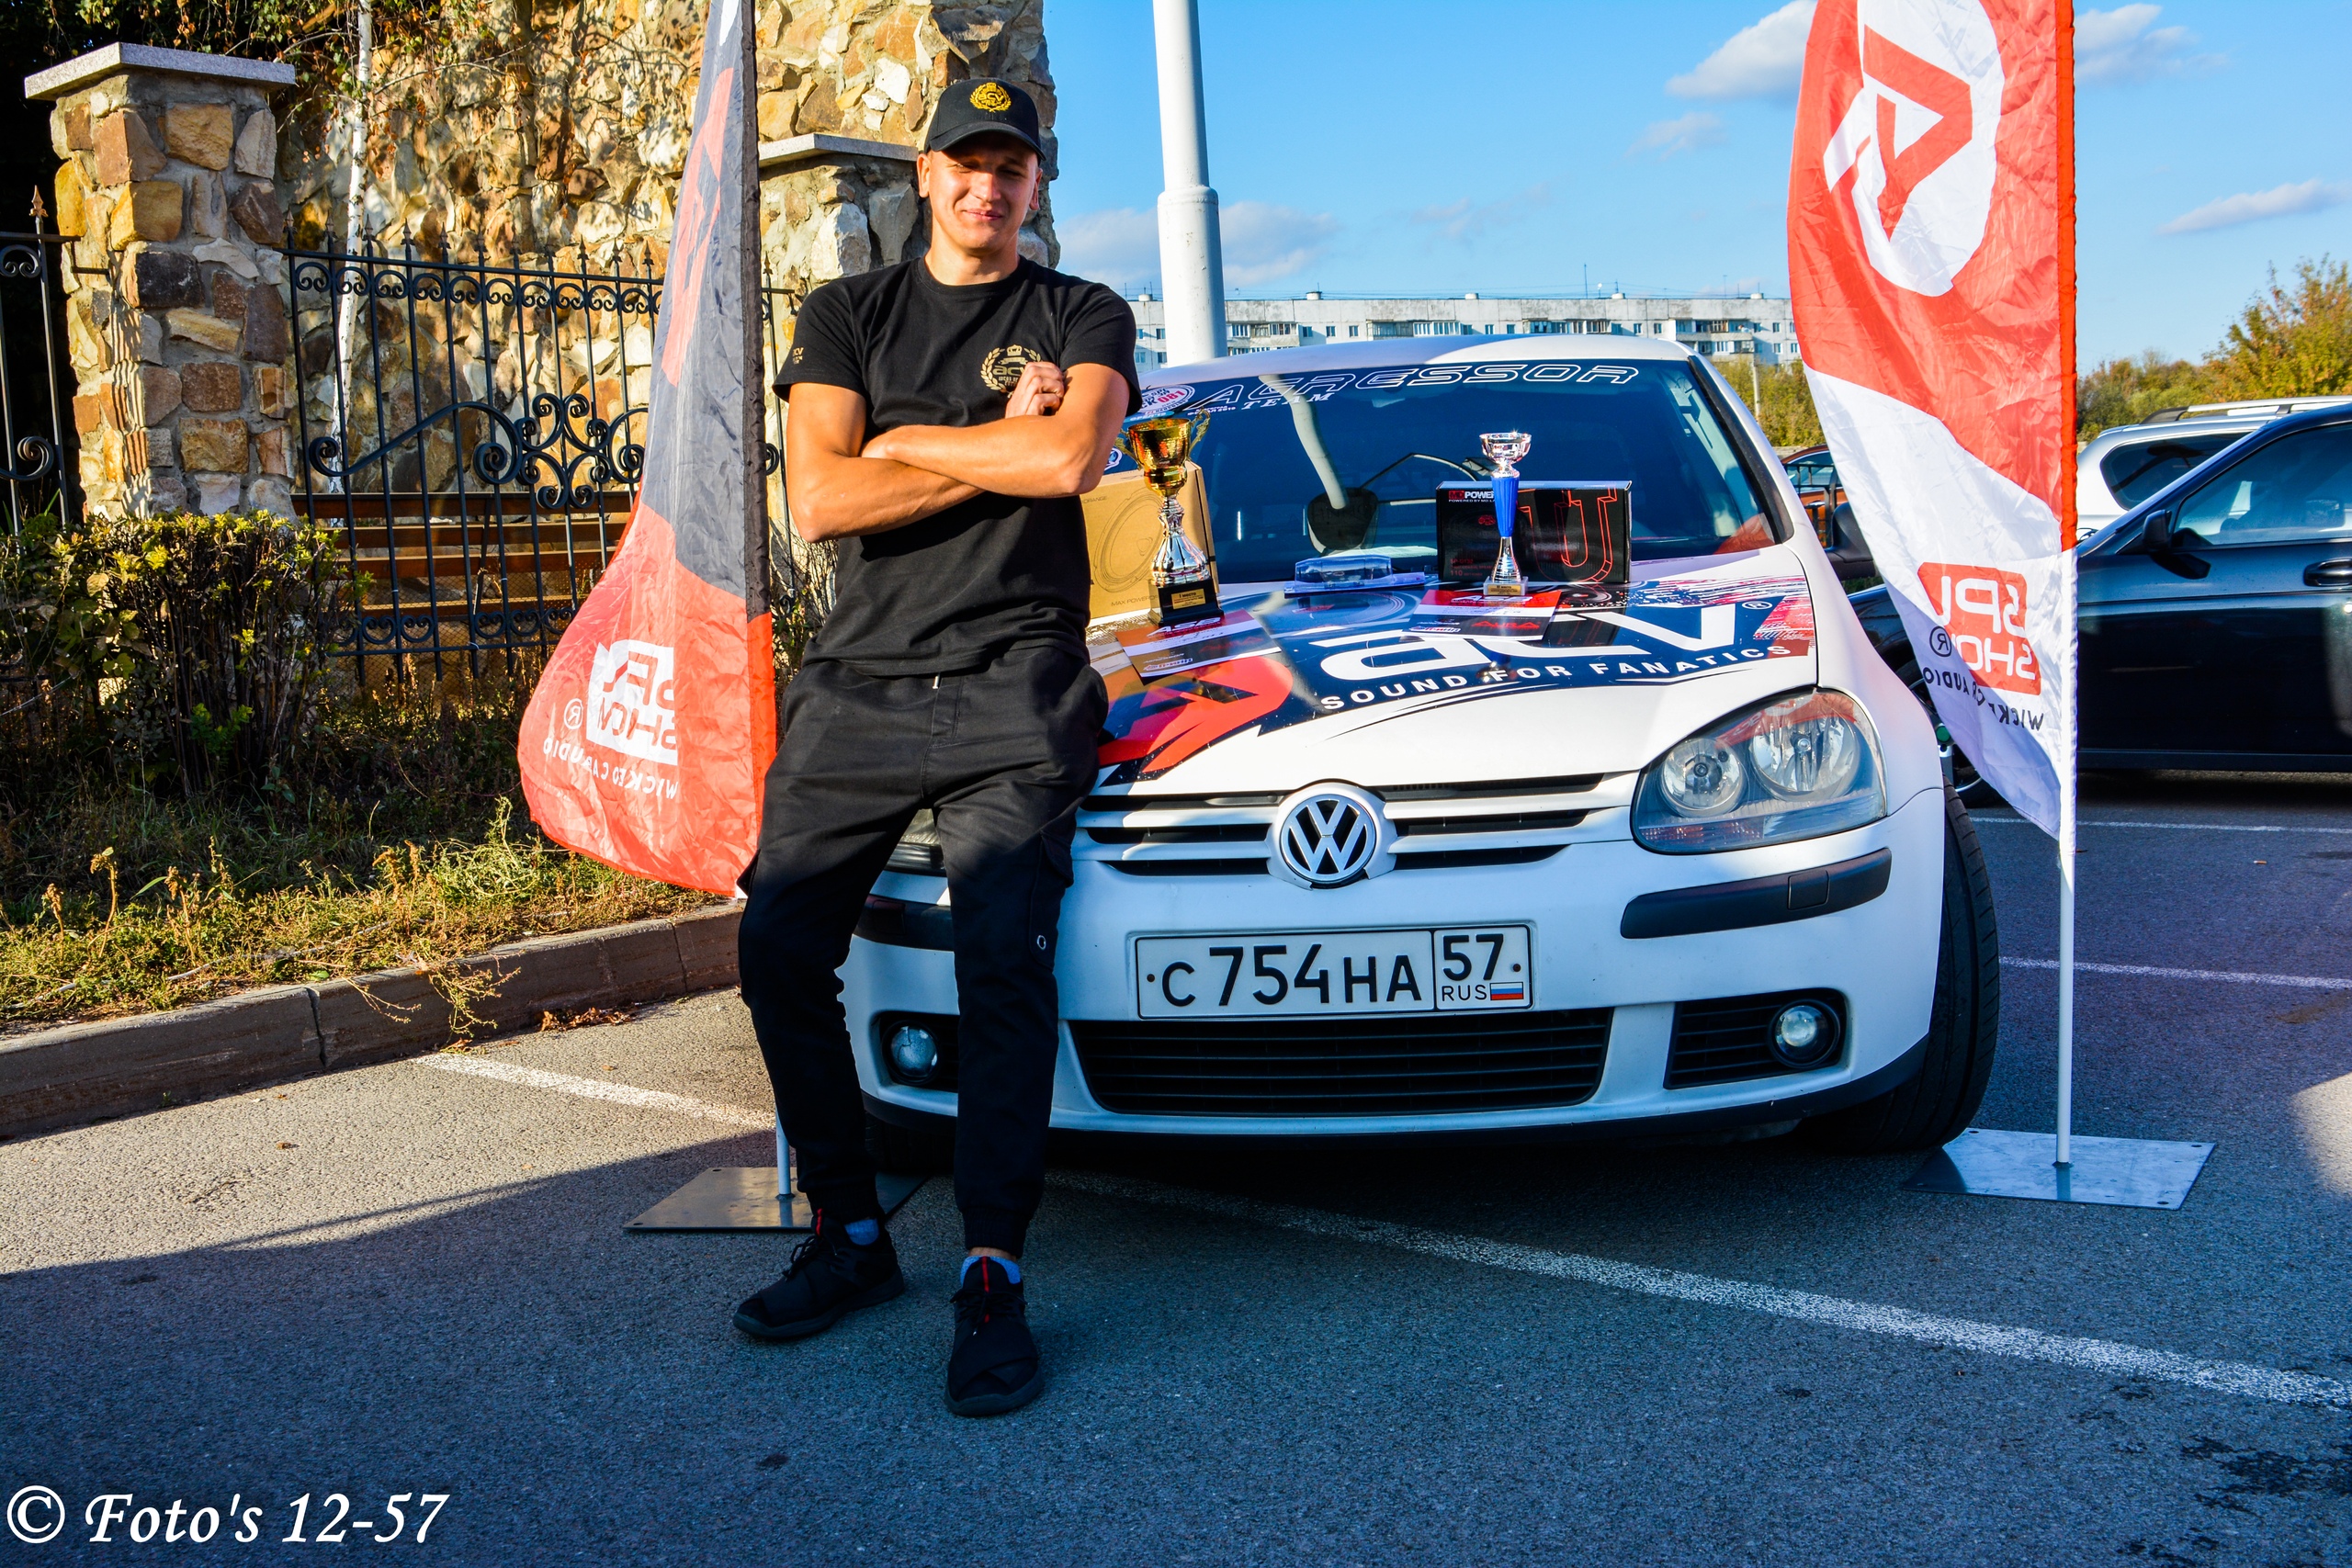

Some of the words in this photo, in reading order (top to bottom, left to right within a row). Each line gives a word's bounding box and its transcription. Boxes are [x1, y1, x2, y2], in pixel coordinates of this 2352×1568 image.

[1157, 390, 1185, 403] 081
[1182, 363, 1639, 412] AGRESSOR
[1240, 392, 1336, 410] TEAM
[1111, 598, 1126, 606] MAX
[1320, 673, 1468, 710] SOUND
[1492, 663, 1572, 682] FOR
[1592, 645, 1793, 675] FANATICS
[1442, 932, 1505, 981] 57
[1441, 983, 1488, 1002] RUS
